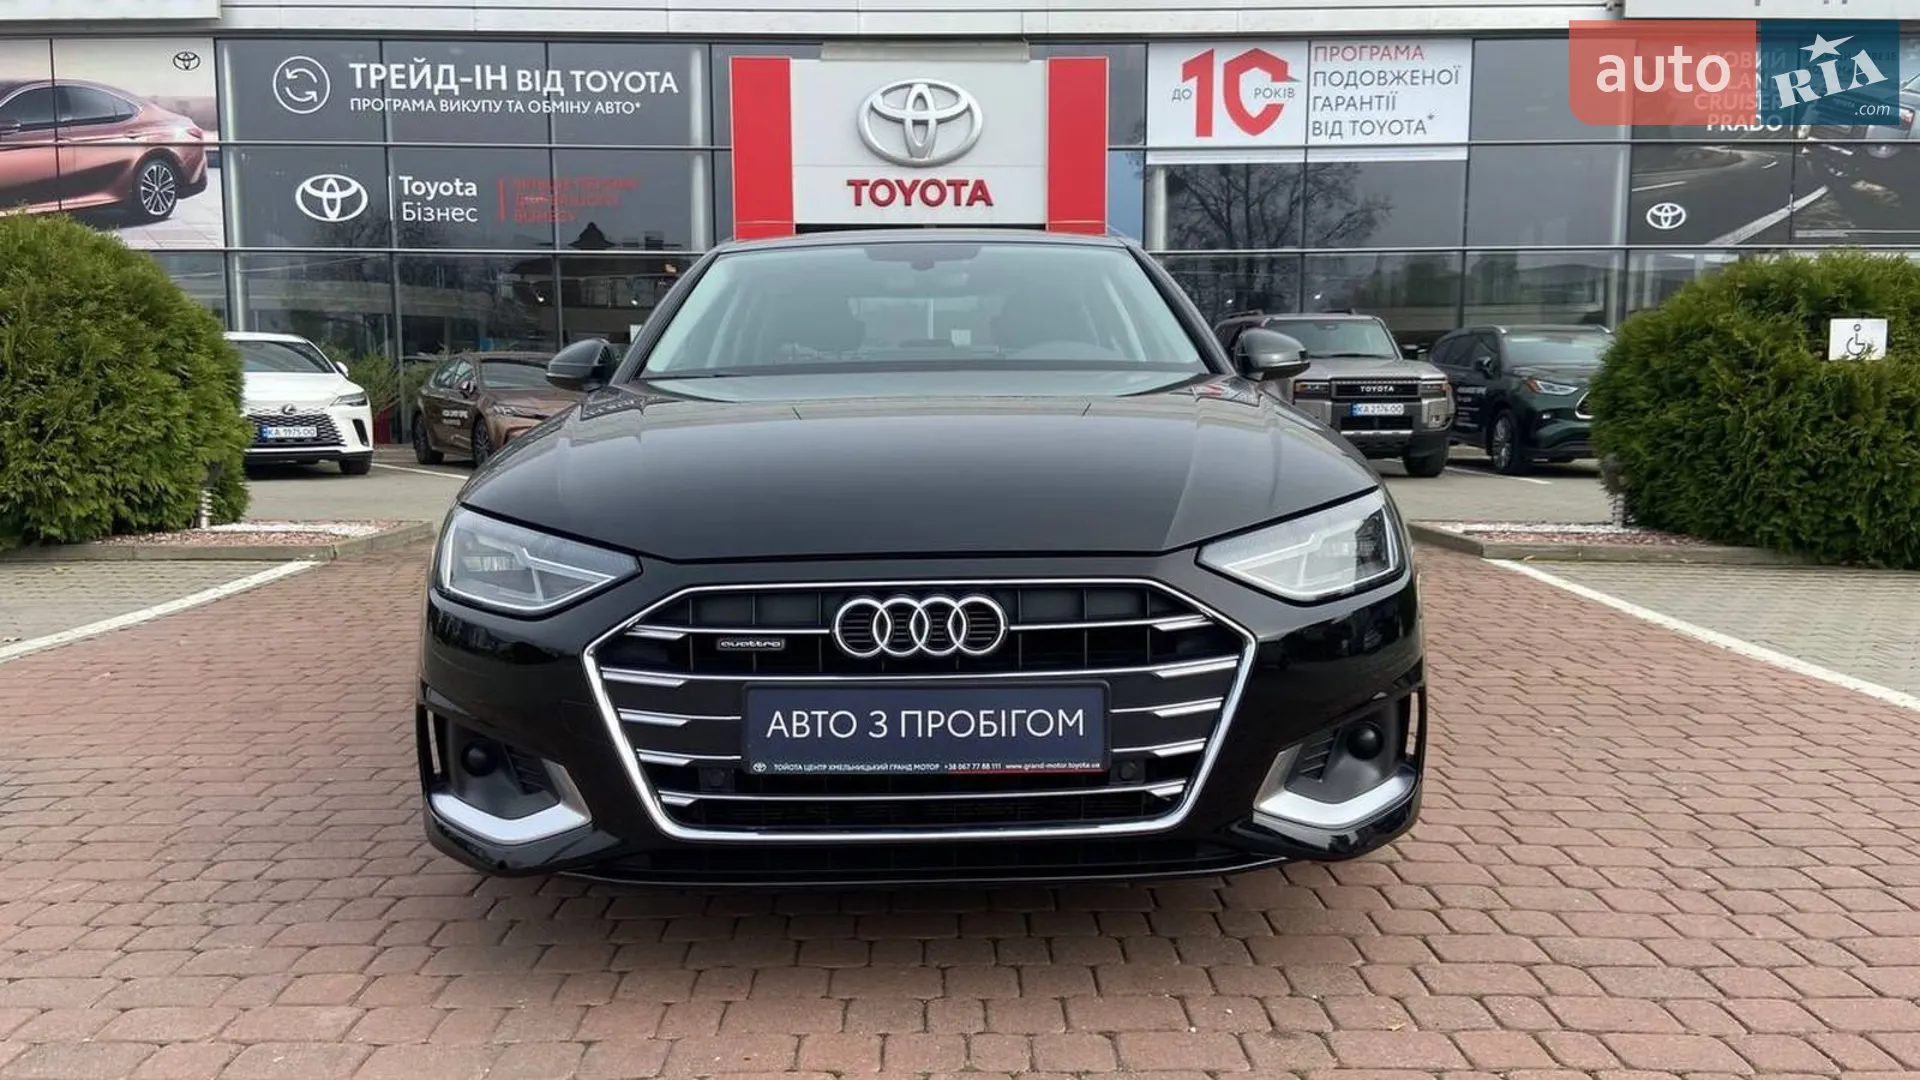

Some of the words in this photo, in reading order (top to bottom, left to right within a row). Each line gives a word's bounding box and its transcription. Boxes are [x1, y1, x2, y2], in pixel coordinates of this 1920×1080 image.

[1314, 45, 1425, 62] ПРОГРАМА
[349, 57, 508, 96] ТРЕЙД-ІН
[516, 70, 565, 97] ВІД
[570, 70, 679, 93] TOYOTA
[1313, 65, 1462, 89] ПОДОВЖЕНОЇ
[1171, 88, 1192, 103] ДО
[1254, 87, 1296, 100] РОКІВ
[1312, 91, 1399, 111] ГАРАНТІЇ
[350, 97, 436, 112] ПРОГРАМА
[440, 99, 503, 113] ВИКУПУ
[506, 100, 525, 113] ТА
[528, 100, 591, 114] ОБМІНУ
[1312, 120, 1343, 139] ВІД
[1706, 113, 1784, 131] PRADO
[399, 175, 478, 200] Toyota
[847, 178, 994, 207] TOYOTA
[402, 202, 479, 222] Бізнес
[1360, 385, 1395, 393] TOYOTA
[720, 639, 781, 649] quattro
[766, 710, 857, 738] АВТО
[900, 709, 1085, 738] ПРОБІГОМ
[774, 763, 802, 771] ТОЙОТА
[913, 763, 940, 771] МОТОР
